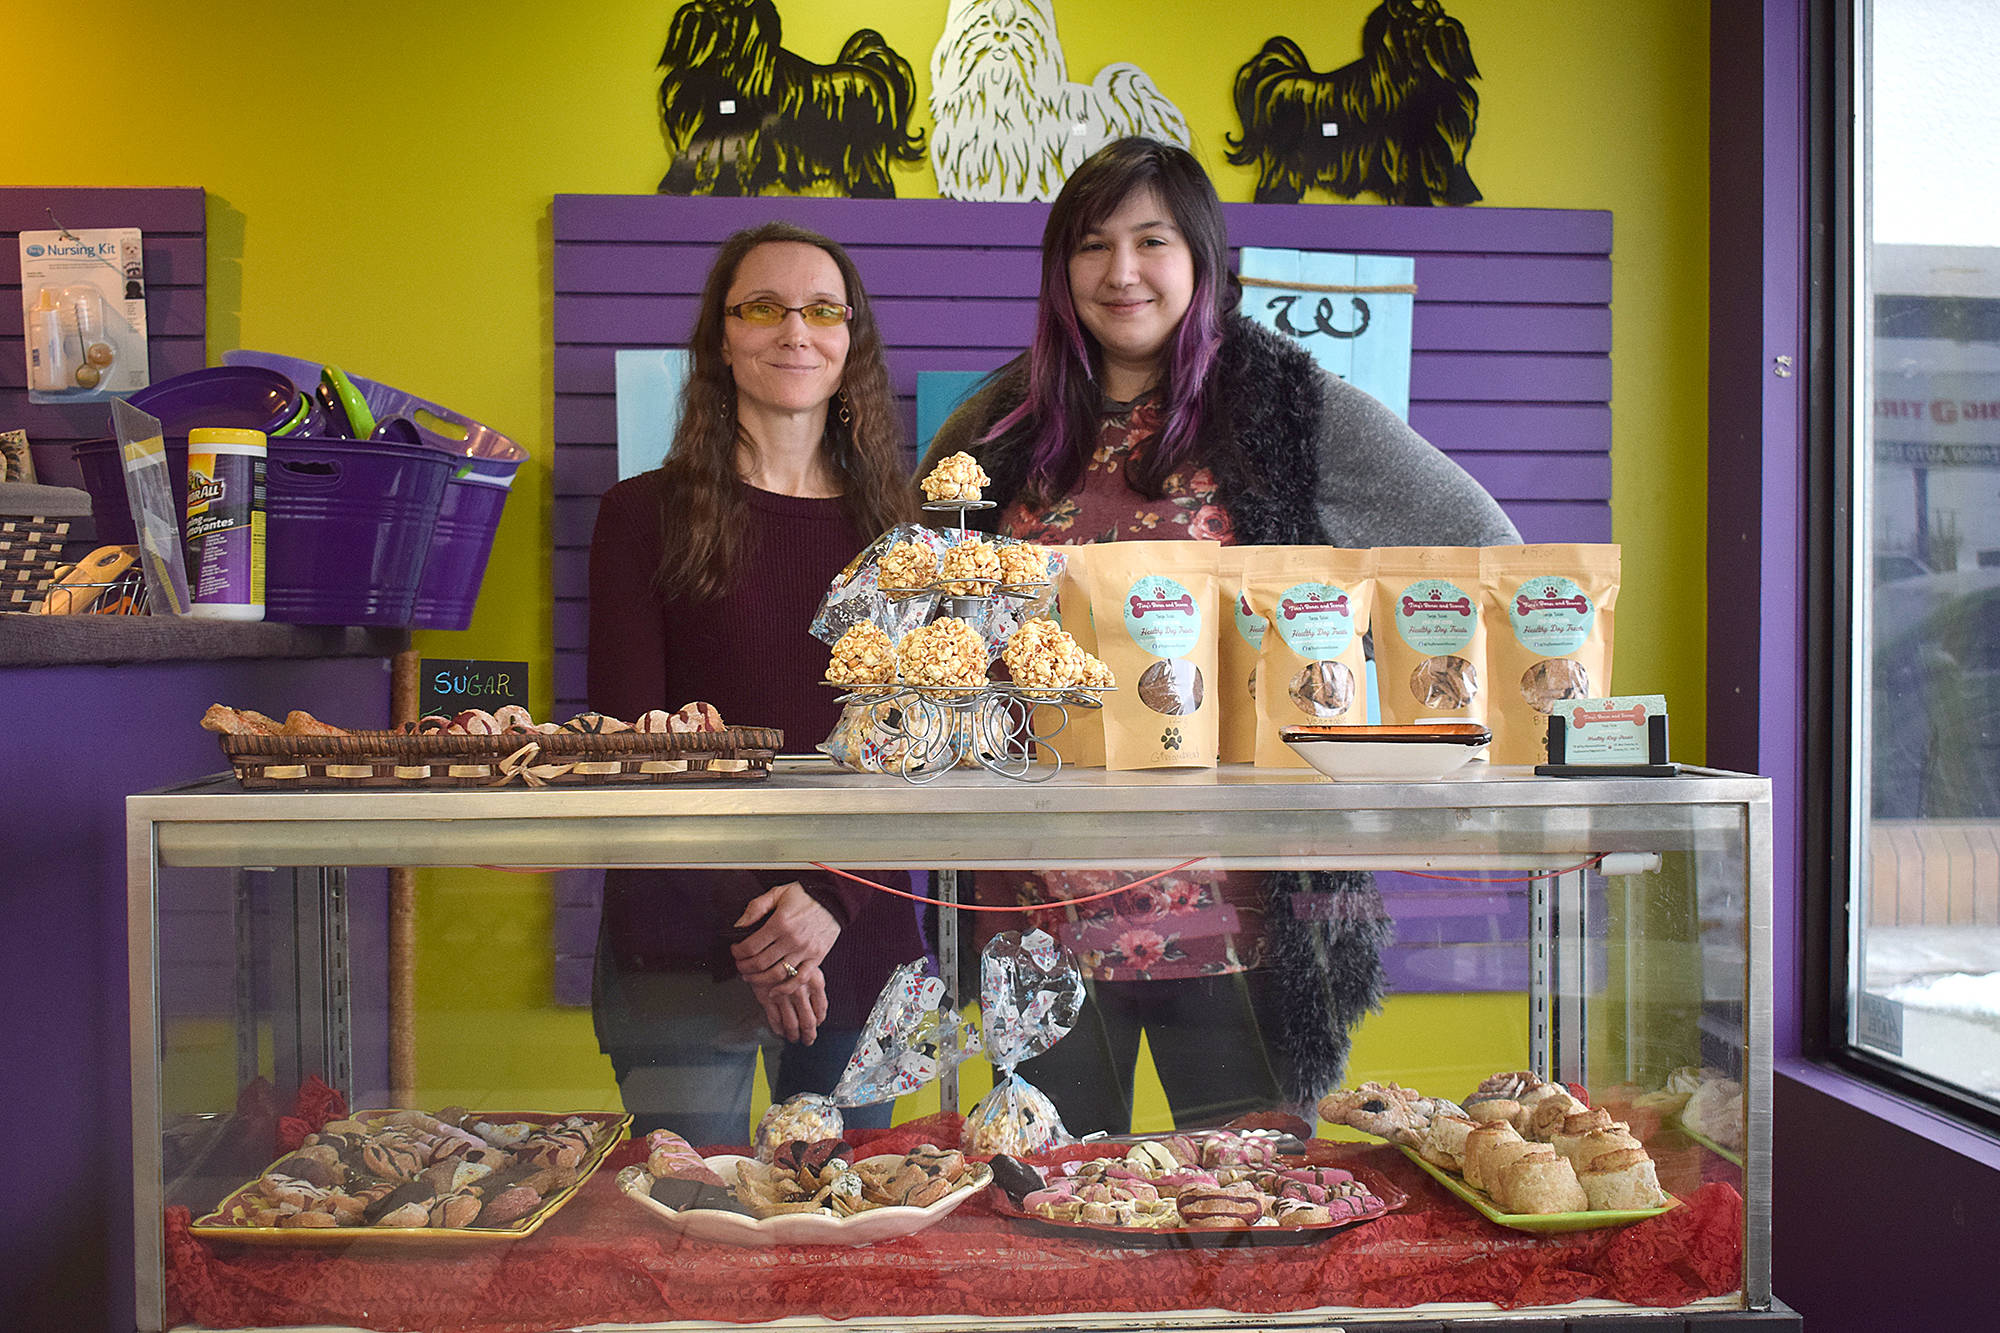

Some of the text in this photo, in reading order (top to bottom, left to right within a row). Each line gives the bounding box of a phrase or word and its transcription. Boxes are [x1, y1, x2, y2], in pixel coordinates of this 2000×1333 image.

[48, 244, 96, 258] Nursing
[99, 243, 116, 255] Kit
[1165, 626, 1177, 636] Dog
[1317, 628, 1330, 637] Dog
[1434, 624, 1447, 634] Dog
[1550, 624, 1564, 634] Dog
[433, 671, 514, 697] SUGAR
